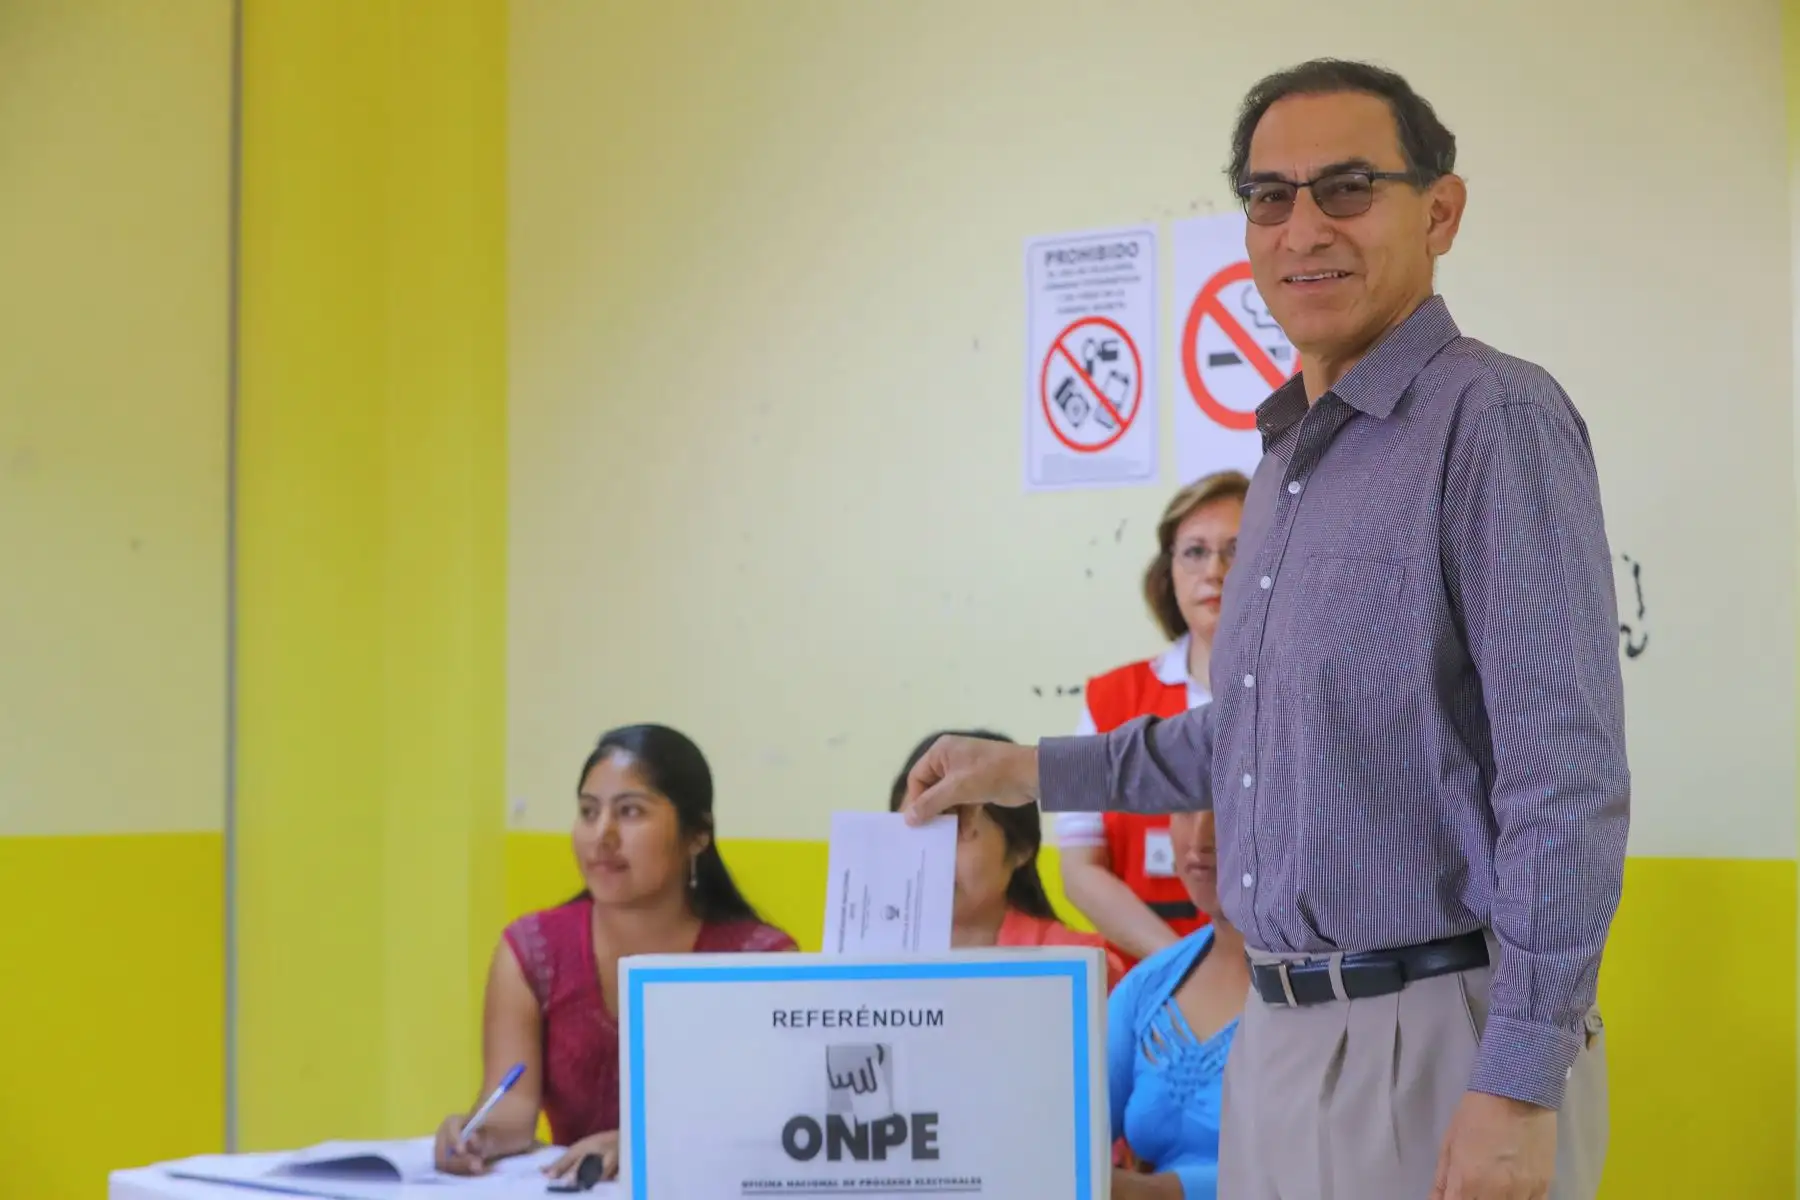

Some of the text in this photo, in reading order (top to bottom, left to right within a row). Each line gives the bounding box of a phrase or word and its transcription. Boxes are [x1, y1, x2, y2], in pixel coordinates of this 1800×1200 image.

[1044, 241, 1140, 266] PROHIBIDO
[772, 1004, 944, 1027] REFERÉNDUM
[782, 1112, 940, 1162] ONPE
[741, 1179, 783, 1188] OFICINA
[786, 1178, 838, 1188] NACIONAL
[842, 1178, 855, 1187] DE
[915, 1176, 982, 1186] ELECTORALES
